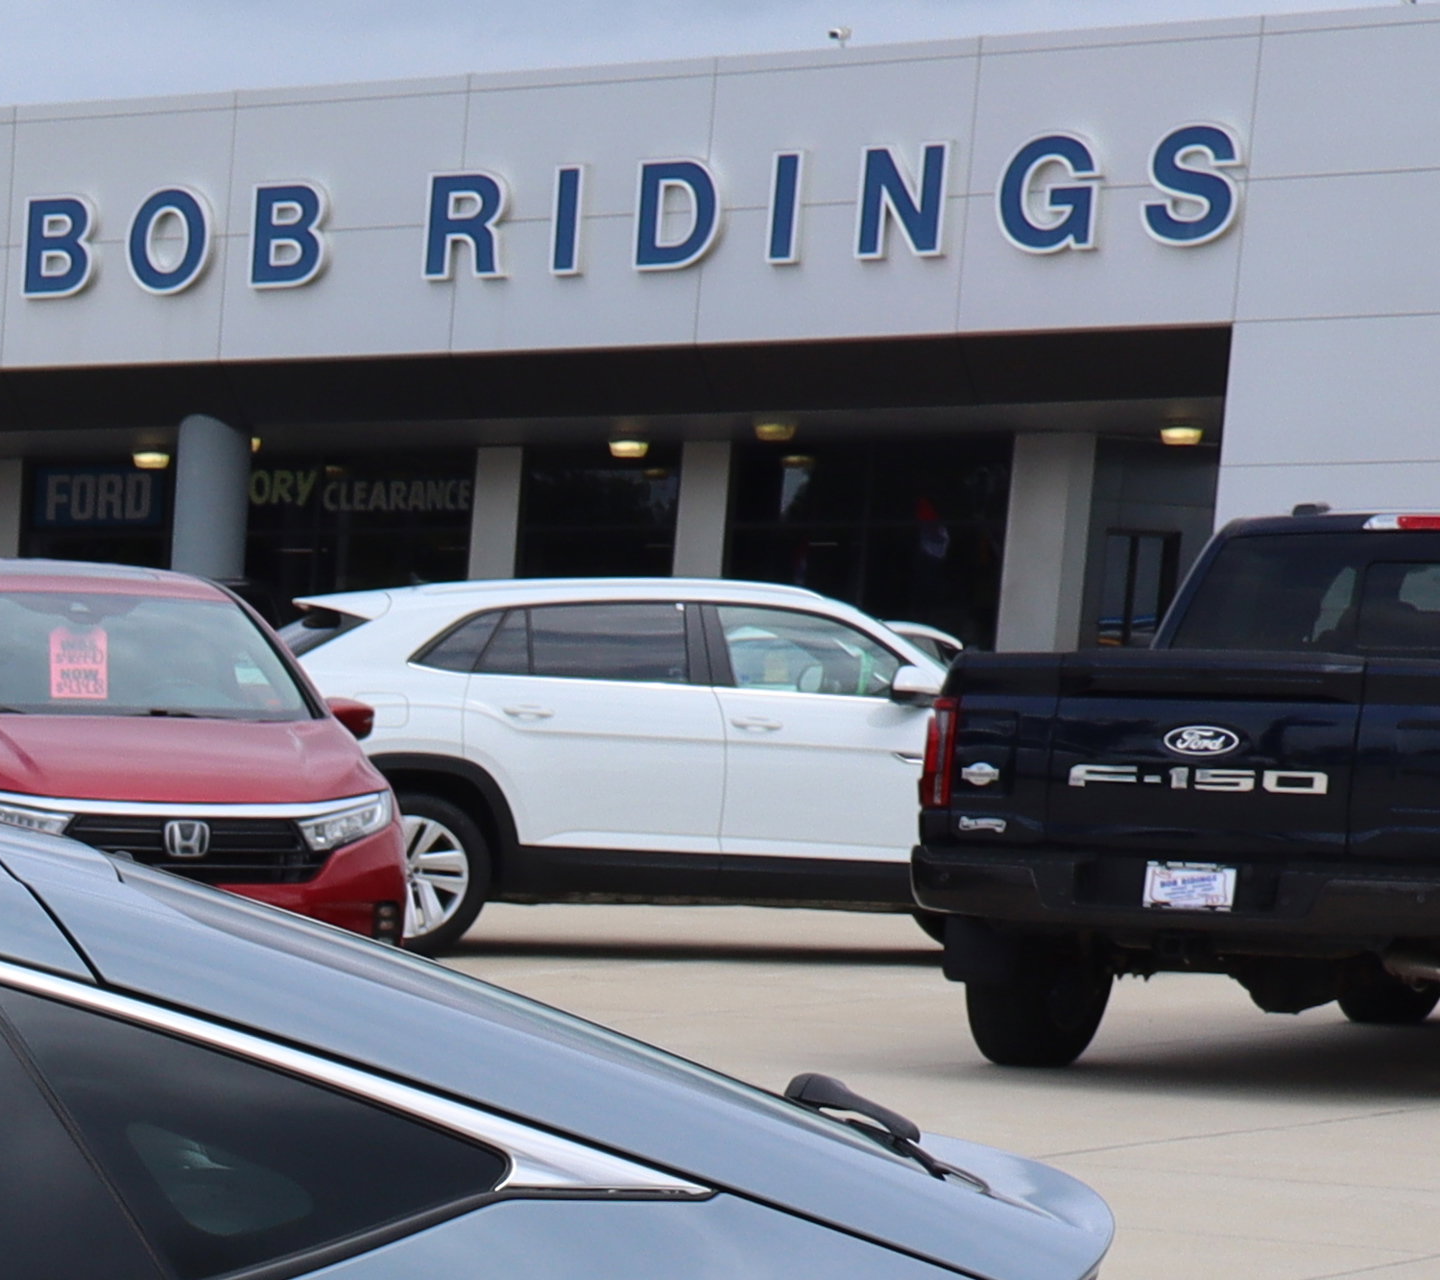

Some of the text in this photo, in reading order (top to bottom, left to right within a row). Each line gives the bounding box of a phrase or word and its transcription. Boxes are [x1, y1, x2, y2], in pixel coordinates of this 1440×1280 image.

[20, 121, 1247, 300] BOB RIDINGS
[45, 473, 152, 521] FORD
[322, 479, 472, 512] CLEARANCE
[60, 668, 99, 681] NOW
[1175, 729, 1227, 751] Ford
[1068, 763, 1329, 795] F-150
